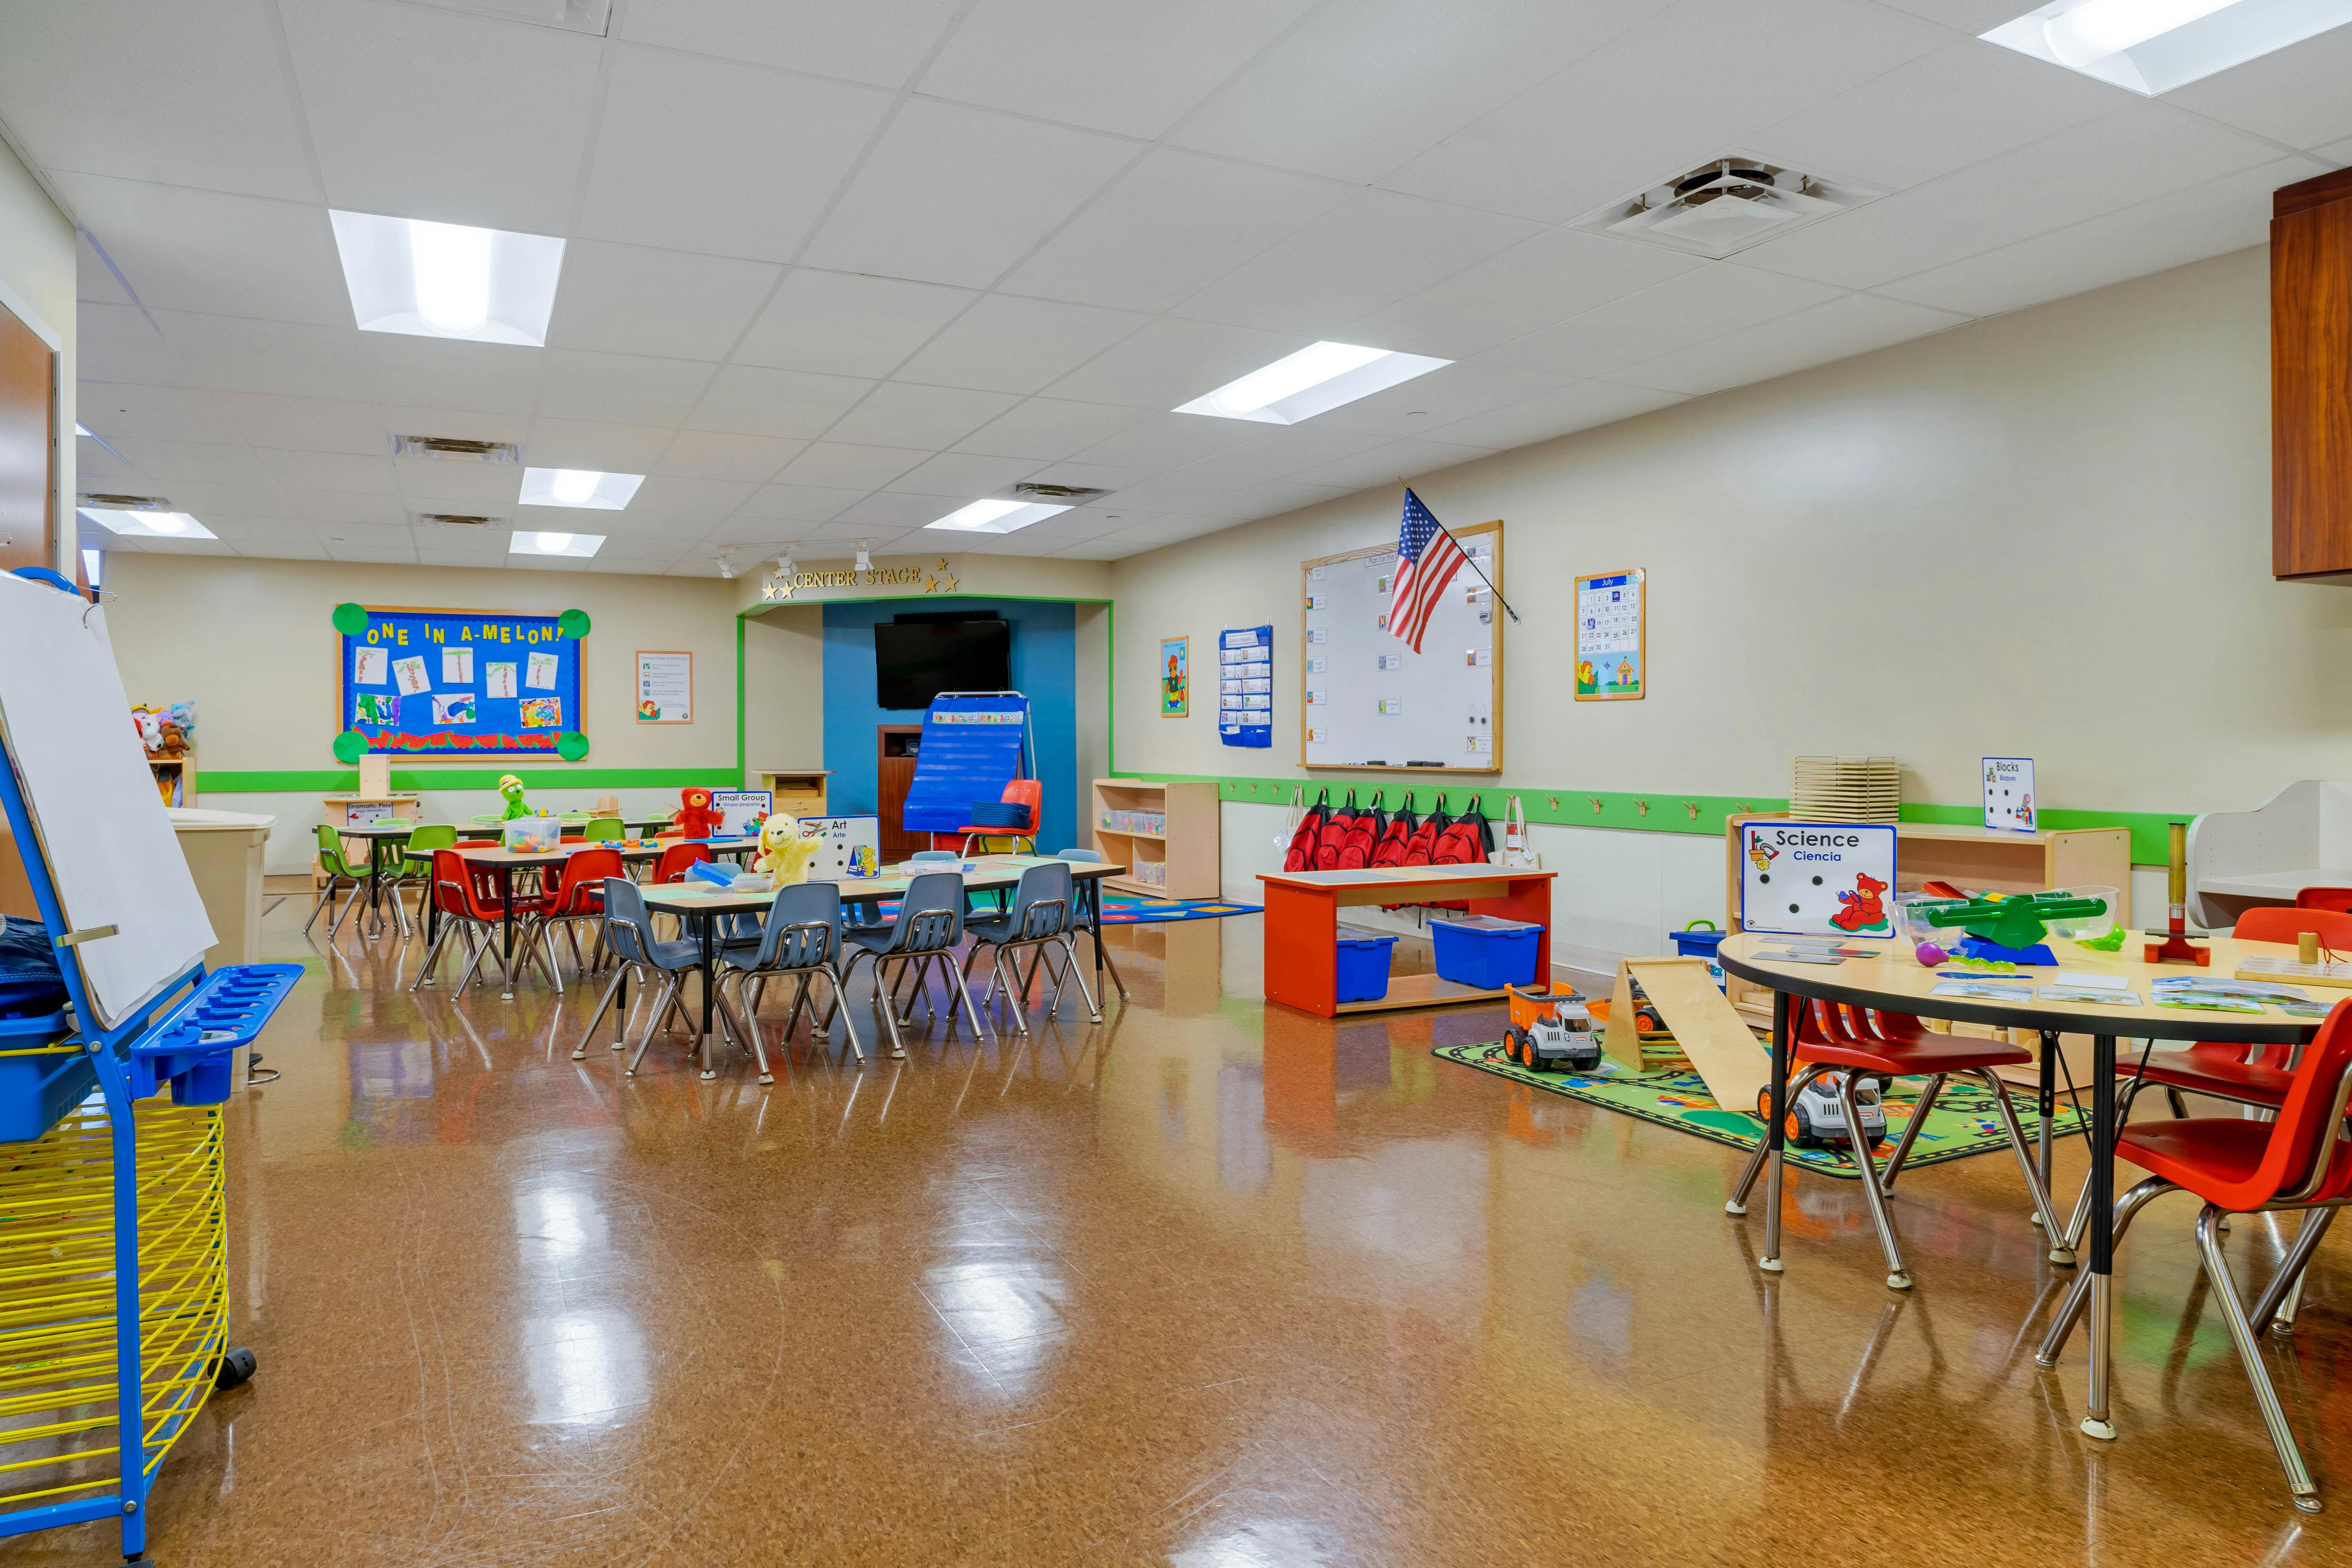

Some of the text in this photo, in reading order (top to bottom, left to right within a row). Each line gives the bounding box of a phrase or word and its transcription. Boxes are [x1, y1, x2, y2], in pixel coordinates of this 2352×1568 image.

[793, 567, 921, 589] CENTER STAGE
[367, 623, 565, 646] ONE IN A-MELON!
[1996, 762, 2019, 771] Blocks
[832, 820, 847, 829] Art
[1776, 830, 1859, 847] Science
[1793, 851, 1841, 862] Ciencia
